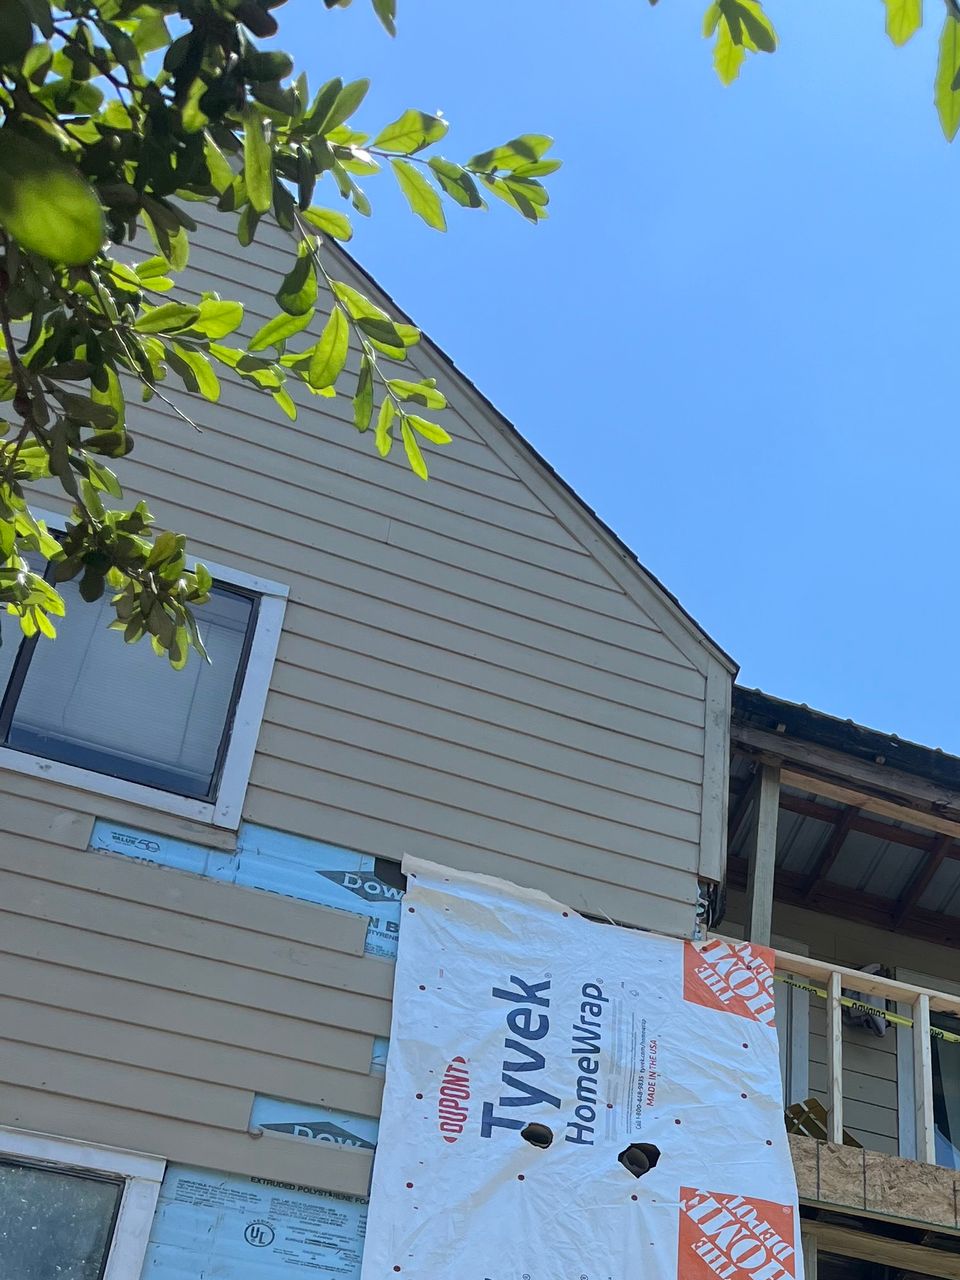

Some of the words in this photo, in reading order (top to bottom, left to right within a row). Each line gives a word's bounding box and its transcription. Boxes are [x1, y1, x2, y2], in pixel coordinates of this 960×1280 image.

[694, 964, 735, 1004] THE
[480, 974, 561, 1138] Tyvek
[649, 1039, 657, 1055] USA
[649, 1056, 657, 1070] THE
[565, 982, 609, 1146] HomeWrap
[648, 1071, 656, 1081] IN
[438, 1064, 470, 1134] DUPONT
[646, 1082, 656, 1107] MADE
[250, 1176, 296, 1191] EXTRUDED
[722, 1195, 795, 1262] DEPOT
